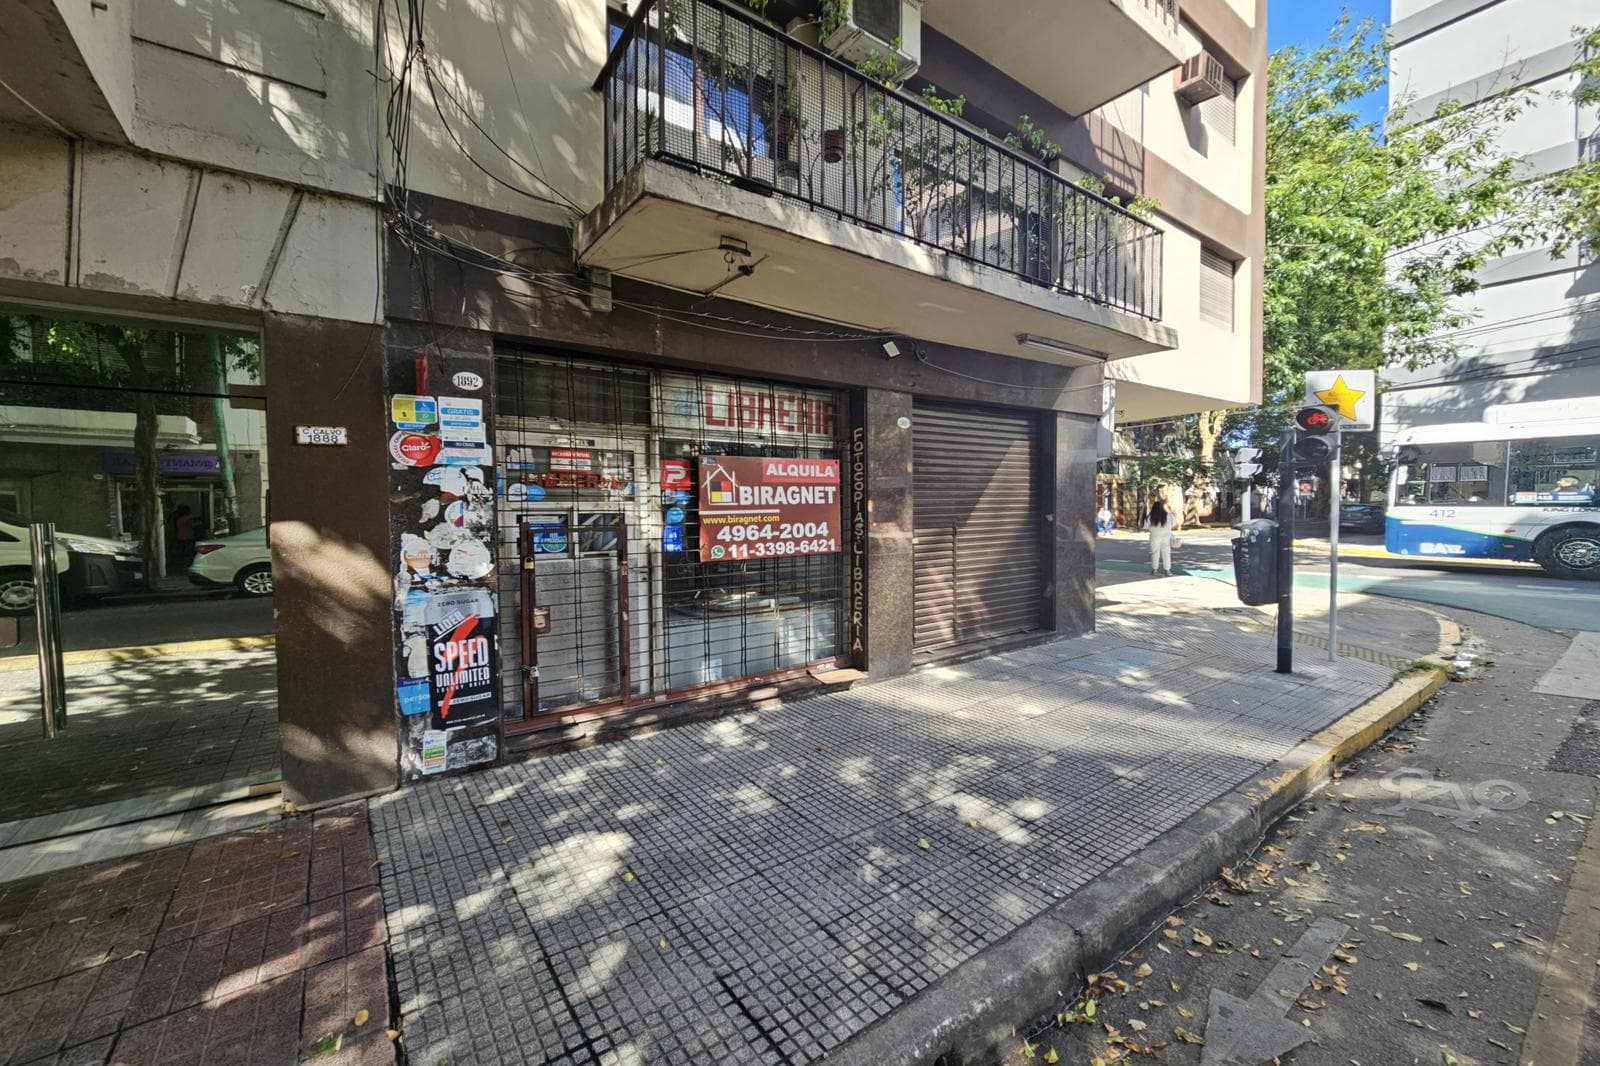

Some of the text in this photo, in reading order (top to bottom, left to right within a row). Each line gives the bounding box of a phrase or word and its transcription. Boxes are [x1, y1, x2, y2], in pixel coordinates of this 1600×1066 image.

[456, 374, 479, 388] 1892
[308, 434, 338, 442] 1888
[401, 442, 427, 452] Claro
[766, 463, 835, 479] ALQUILA
[740, 485, 836, 505] BIRAGNET
[703, 514, 780, 524] www.biragnet.com
[1429, 509, 1456, 518] 412
[717, 522, 829, 542] 4964-2004
[728, 538, 836, 558] 11-3398-6421
[853, 542, 864, 652] LIBRERIA
[432, 610, 466, 636] LIDER
[434, 636, 489, 673] SPEED
[435, 666, 490, 688] UNLIMITED
